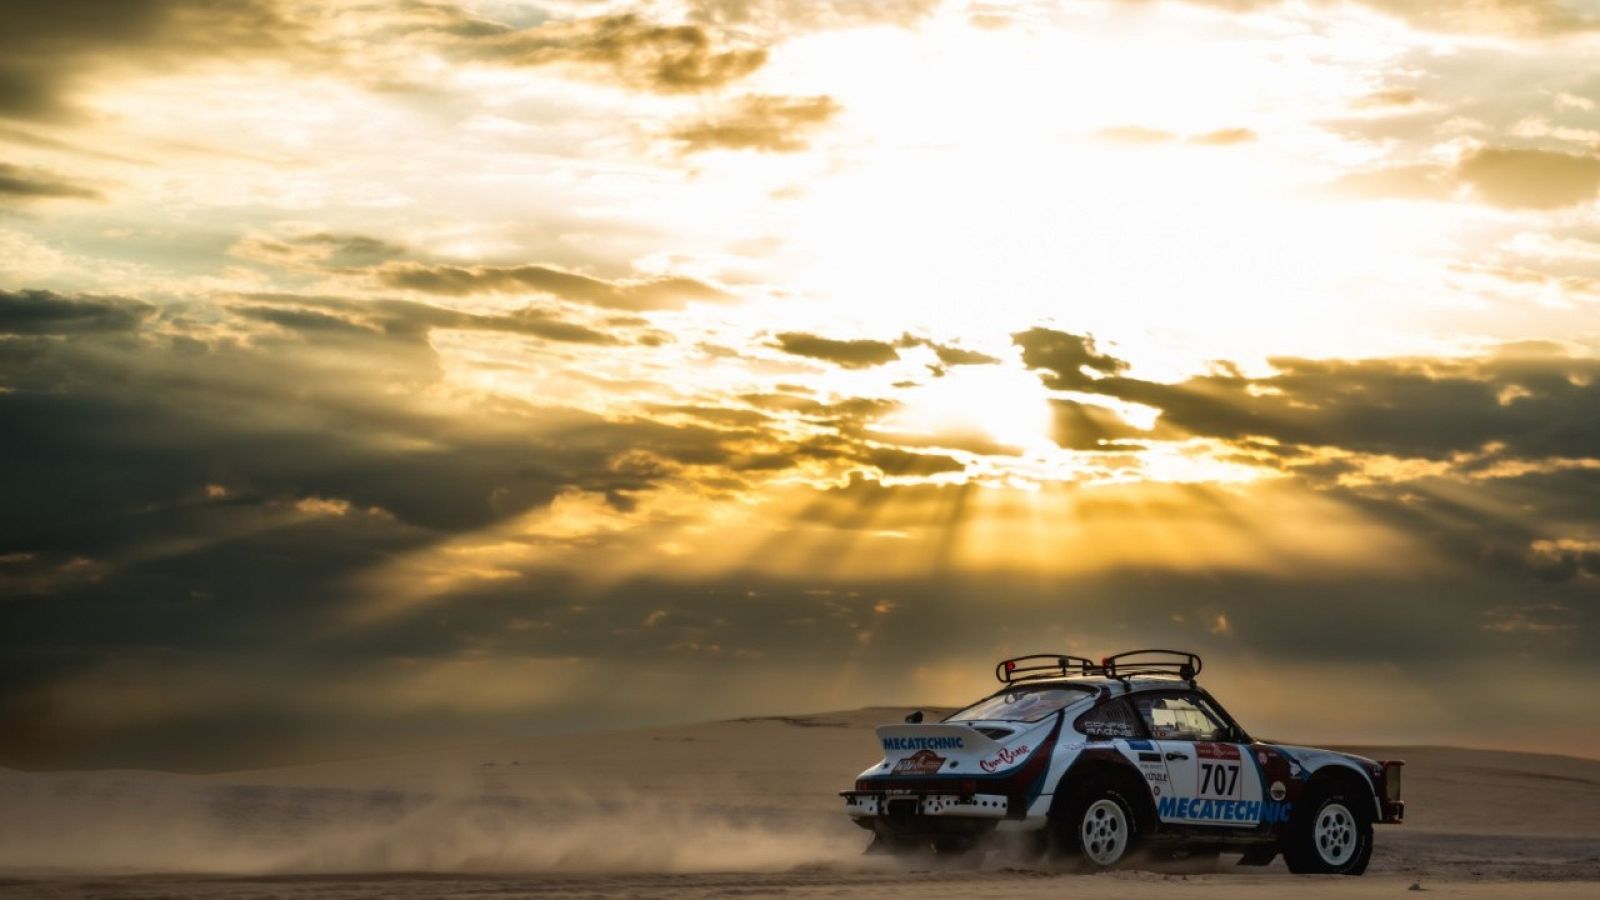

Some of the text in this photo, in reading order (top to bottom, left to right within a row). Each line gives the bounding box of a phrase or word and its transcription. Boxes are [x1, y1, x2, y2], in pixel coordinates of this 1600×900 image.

[884, 737, 963, 750] MECATECHNIC
[1201, 763, 1240, 796] 707
[1158, 797, 1292, 823] MECATECHNIC
